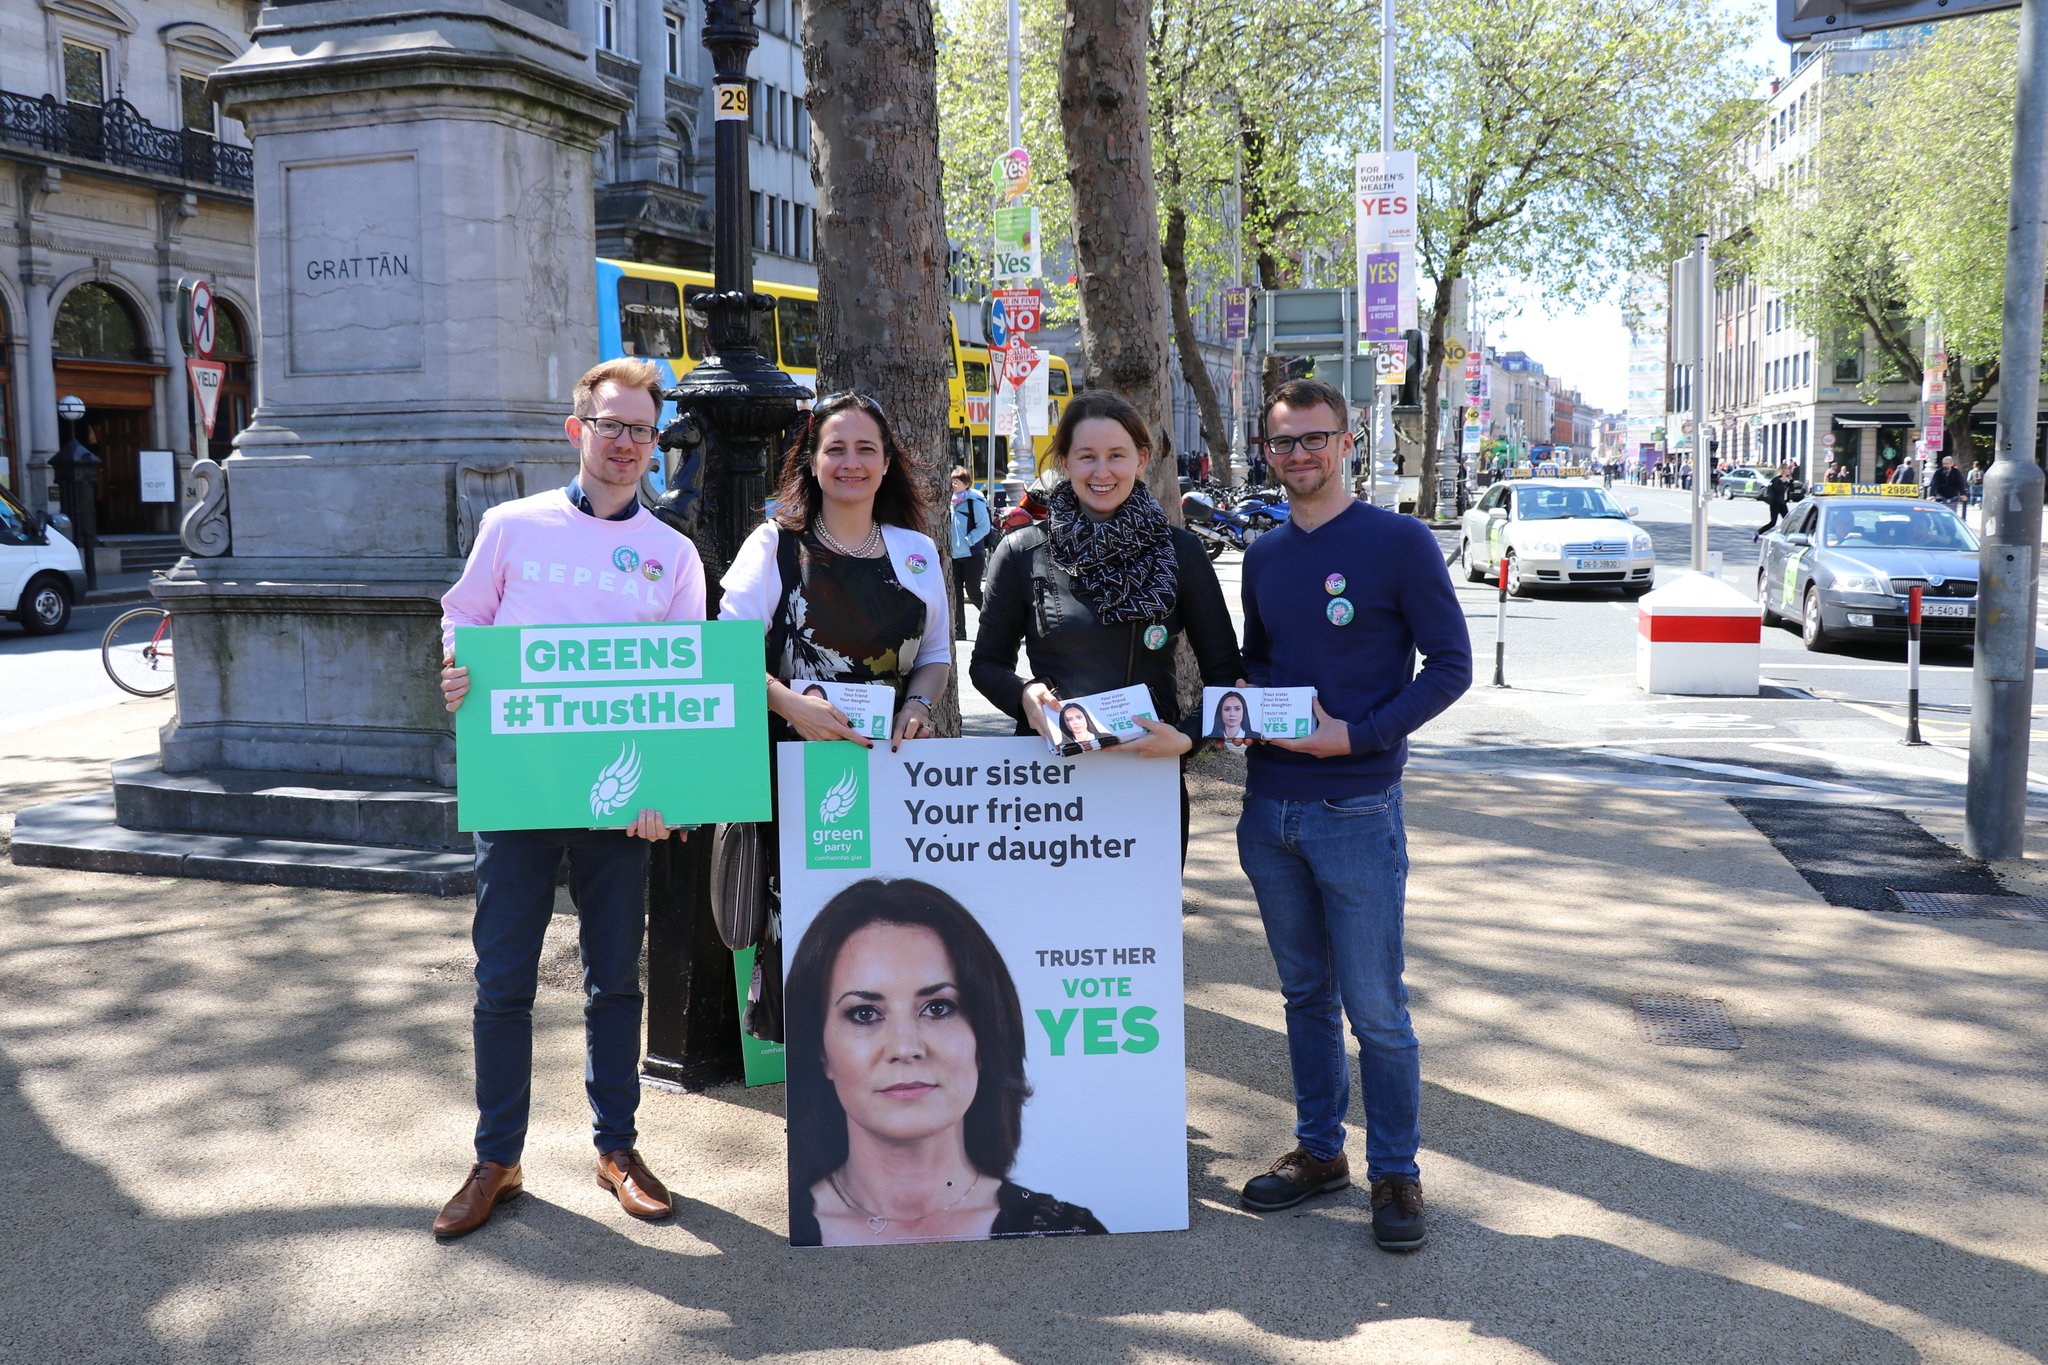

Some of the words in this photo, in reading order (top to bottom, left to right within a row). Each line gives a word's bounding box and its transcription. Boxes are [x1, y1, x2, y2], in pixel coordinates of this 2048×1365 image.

[721, 90, 746, 111] 29
[1361, 173, 1404, 182] WOMEN'S
[1361, 183, 1394, 191] HEALTH
[1362, 197, 1408, 216] YES
[996, 253, 1031, 274] Yes
[1368, 262, 1398, 284] YES
[1228, 293, 1245, 305] YES
[1005, 311, 1034, 330] NO
[1010, 335, 1020, 349] 6
[1444, 347, 1466, 360] NO
[195, 371, 218, 387] YIELD
[1006, 361, 1031, 378] NO
[1535, 469, 1555, 477] TAXI
[1853, 485, 1880, 494] TAXI
[1888, 486, 1917, 494] 29864
[522, 561, 658, 606] REPEAL
[525, 636, 696, 672] GREENS
[503, 691, 720, 727] #TrustHer
[1109, 720, 1134, 731] YES
[1263, 723, 1288, 732] YES
[904, 761, 978, 787] Your
[986, 759, 1075, 785] sister
[904, 799, 979, 825] Your
[988, 796, 1083, 824] friend
[812, 829, 863, 845] green
[824, 843, 852, 853] party
[905, 837, 979, 863] Your
[988, 834, 1136, 867] daughter
[1035, 949, 1107, 967] TRUST
[1113, 947, 1156, 964] HER
[1062, 977, 1132, 998] VOTE
[1034, 1005, 1160, 1057] YES
